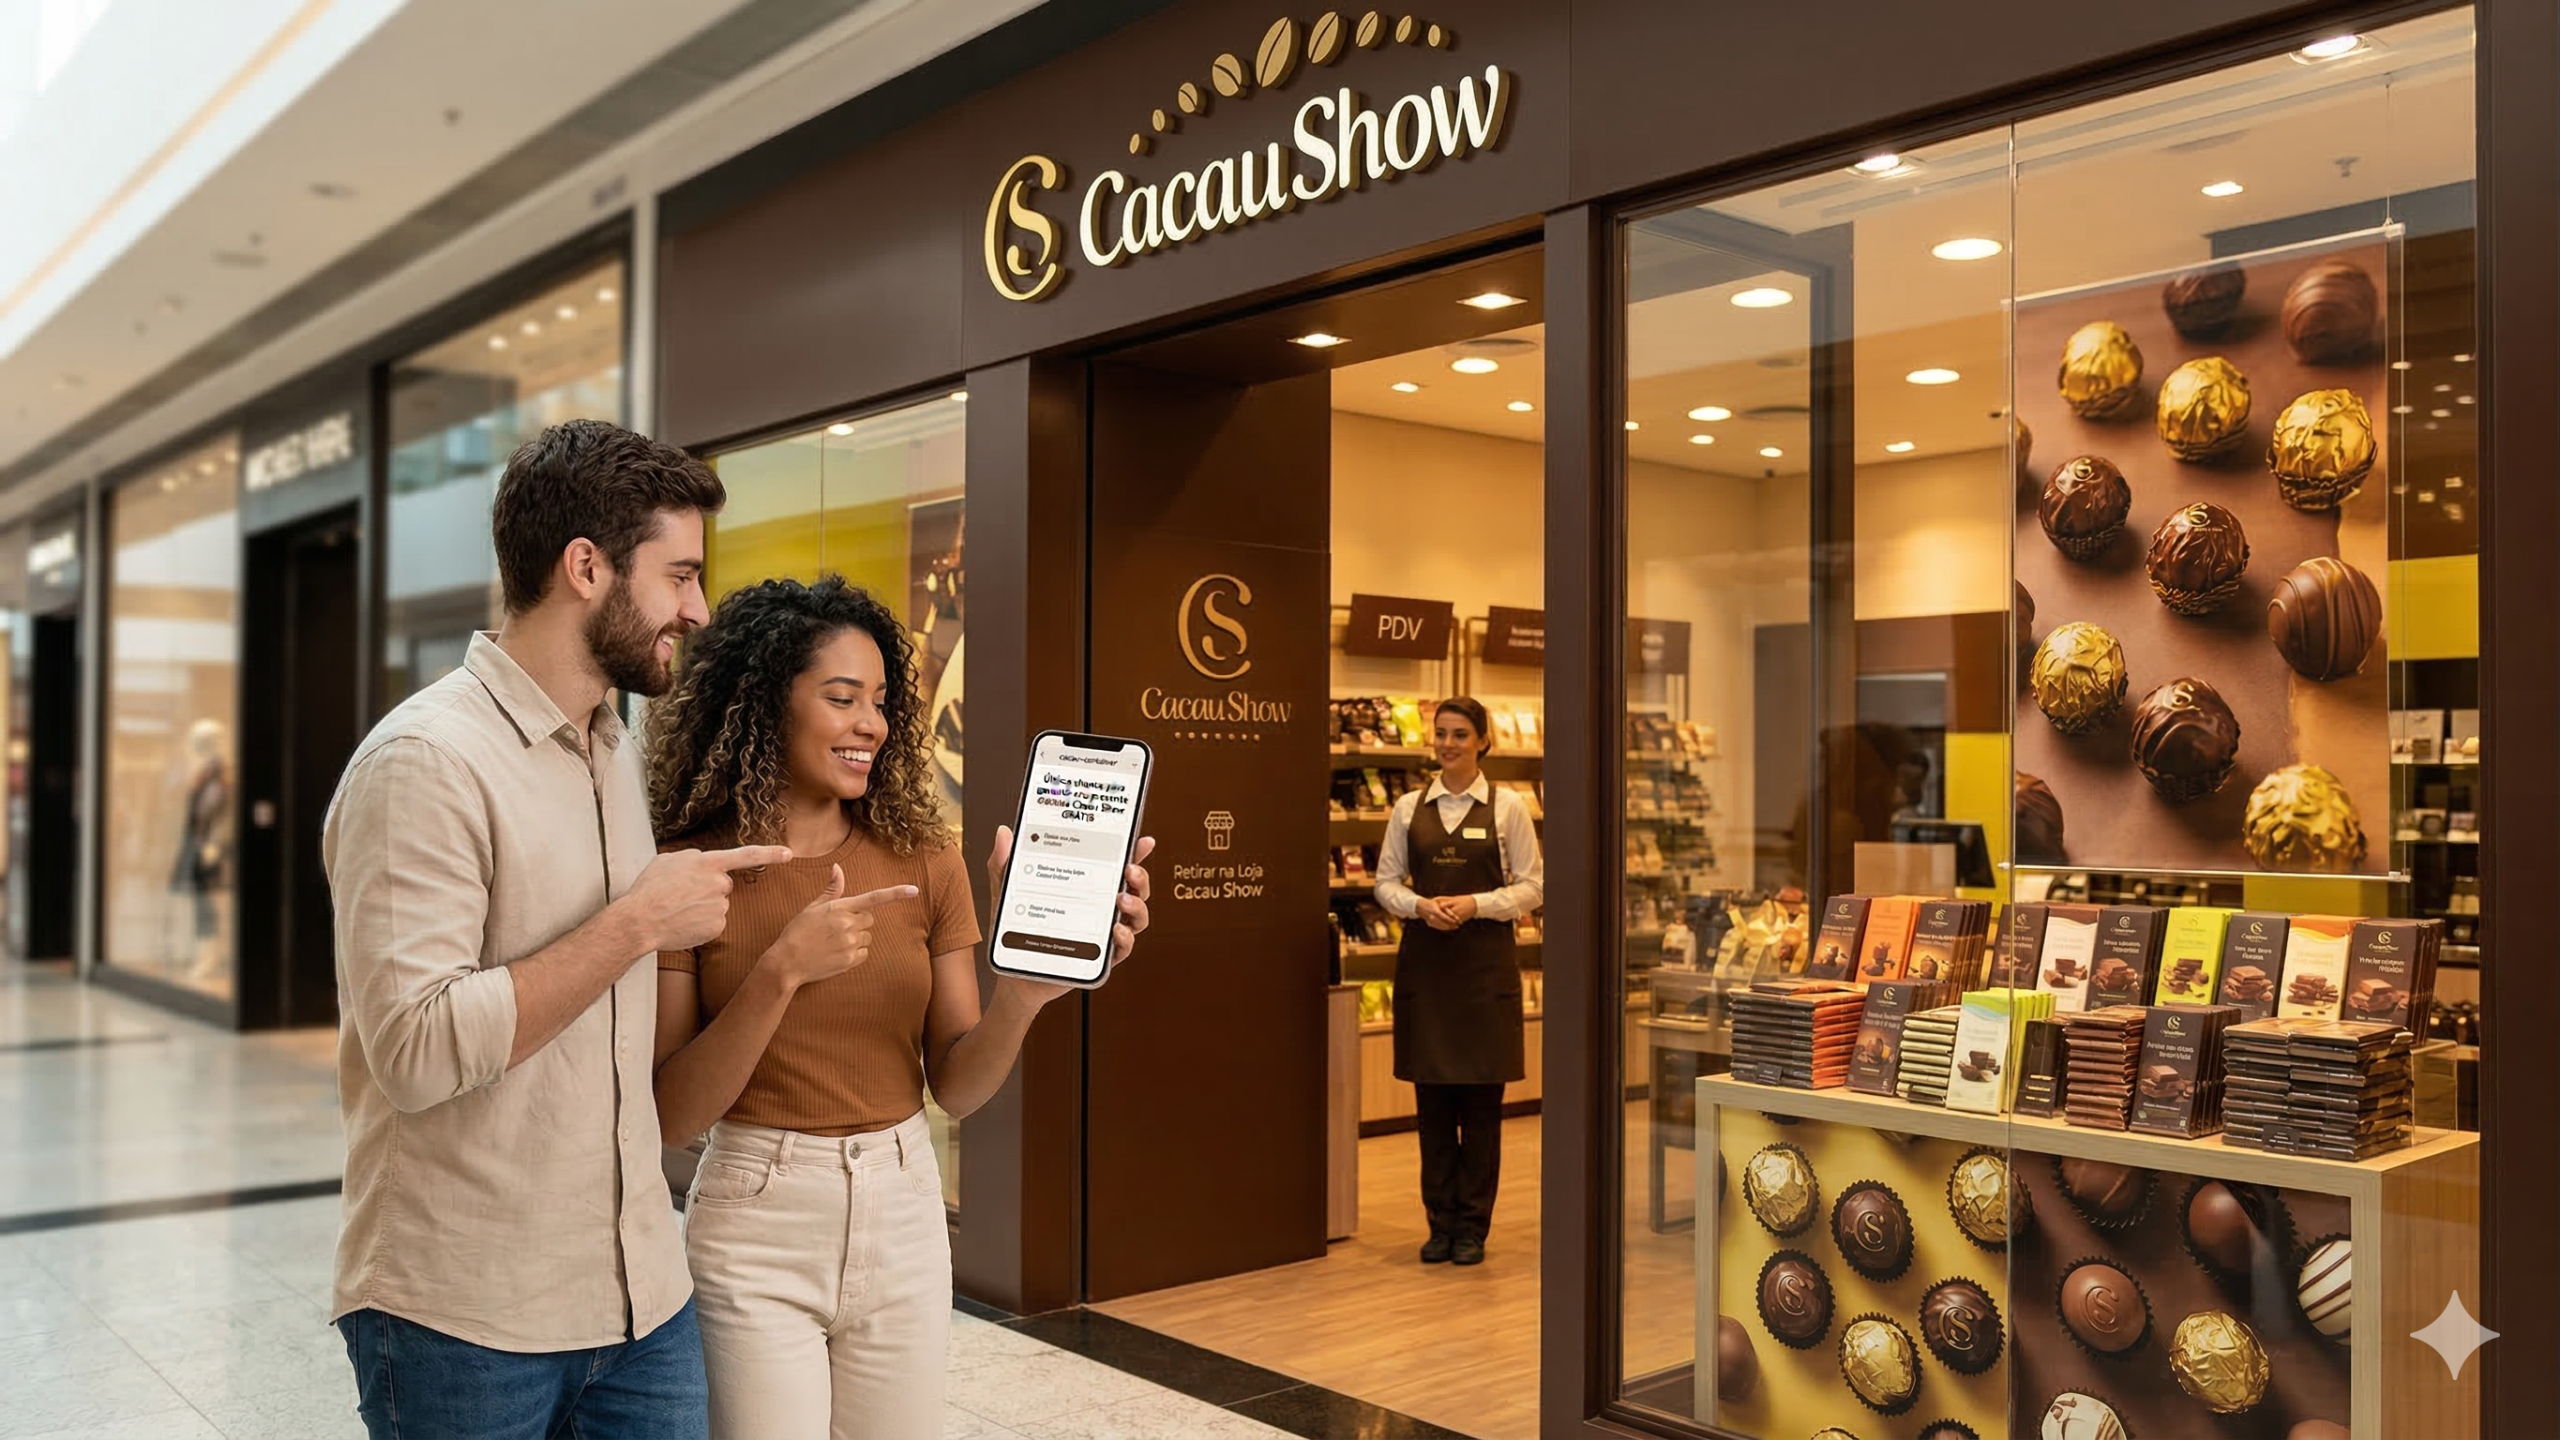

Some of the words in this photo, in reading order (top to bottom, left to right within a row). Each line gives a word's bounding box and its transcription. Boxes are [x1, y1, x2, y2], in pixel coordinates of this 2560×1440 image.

[1377, 614, 1425, 642] PDV
[1173, 863, 1217, 880] Retirar
[1219, 866, 1235, 879] na
[1238, 862, 1264, 882] Loja
[1173, 883, 1220, 900] Cacau
[1222, 881, 1264, 899] Show
